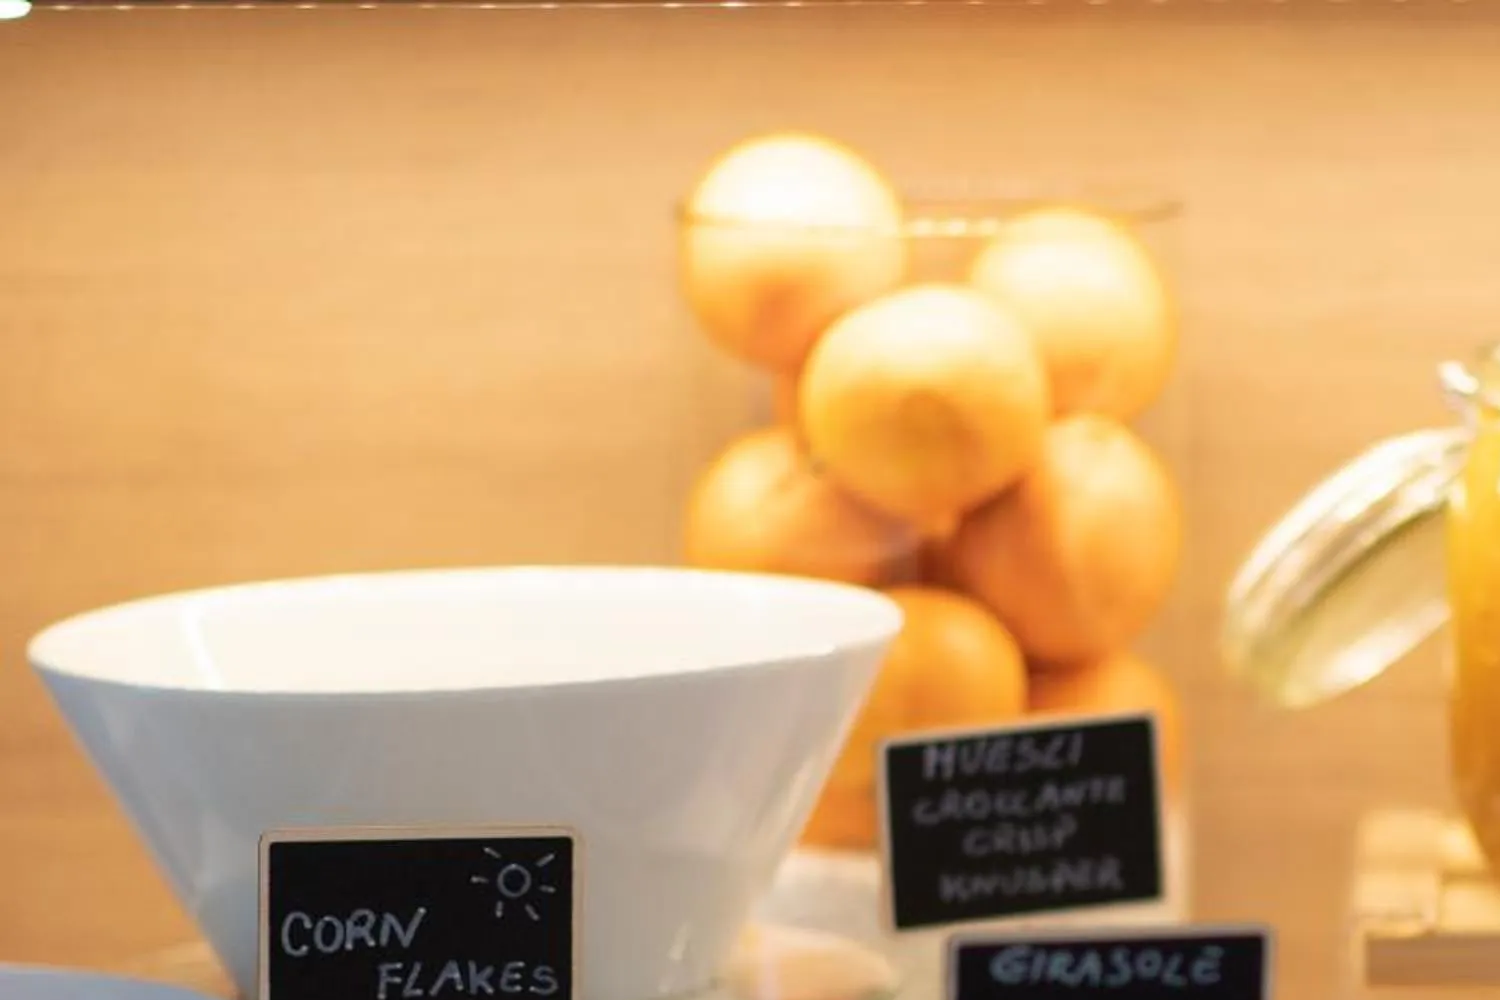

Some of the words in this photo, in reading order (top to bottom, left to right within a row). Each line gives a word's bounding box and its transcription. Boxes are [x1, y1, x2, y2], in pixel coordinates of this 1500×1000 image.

[281, 907, 427, 957] CORN
[376, 960, 559, 1000] FLAKES
[989, 945, 1225, 987] GIRASOLE
